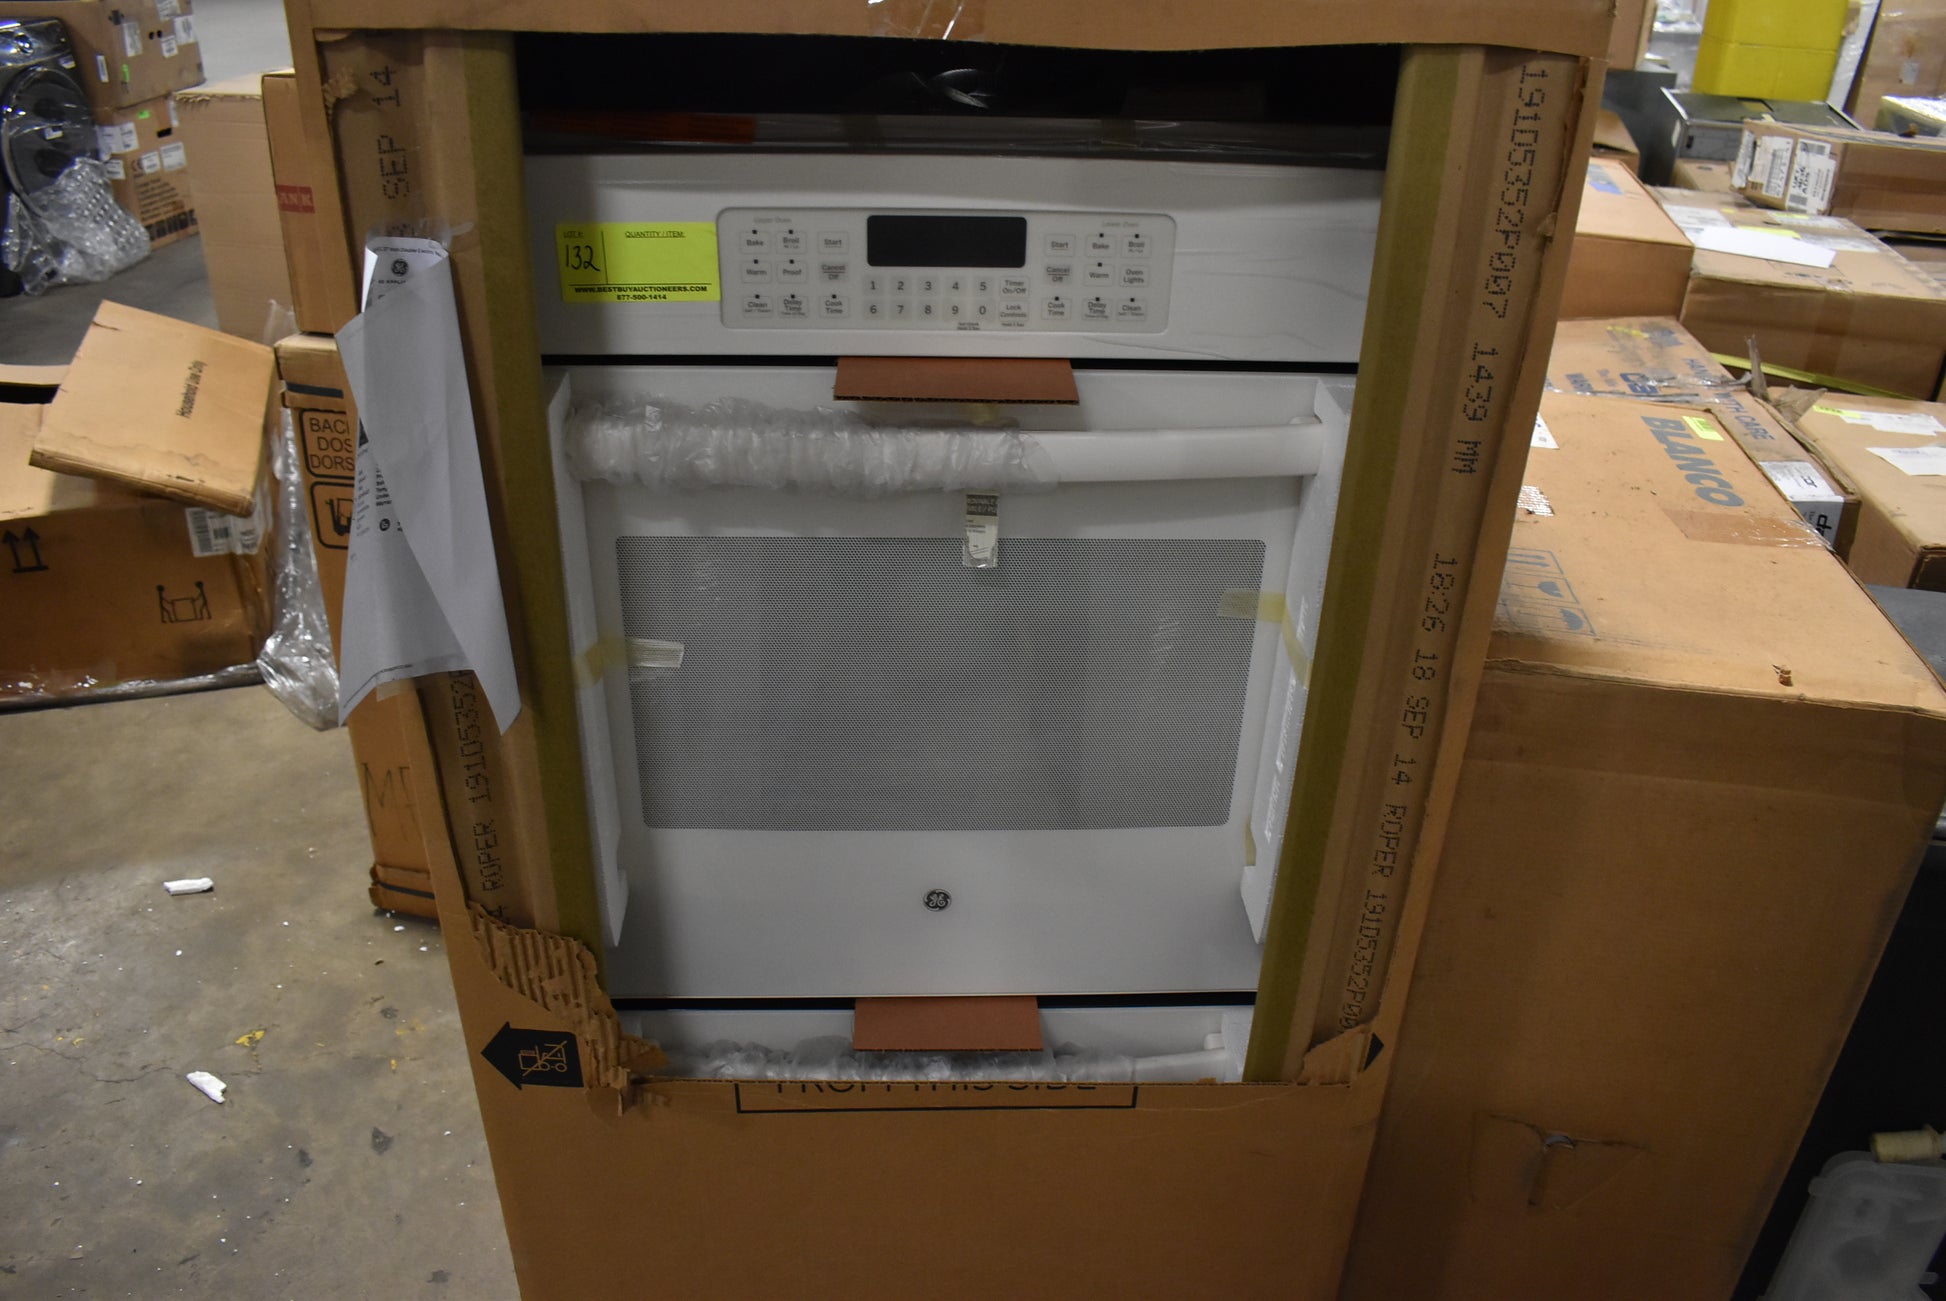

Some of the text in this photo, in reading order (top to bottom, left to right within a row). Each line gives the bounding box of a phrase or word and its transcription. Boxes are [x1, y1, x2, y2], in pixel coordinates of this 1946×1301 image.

[370, 65, 400, 107] 14
[378, 134, 410, 199] SEP
[746, 239, 764, 247] Bake
[565, 244, 600, 272] 132
[870, 281, 876, 290] 1
[897, 281, 904, 291] 2
[925, 281, 932, 291] 3
[952, 281, 960, 291] 4
[980, 282, 987, 291] 5
[870, 305, 877, 314] 6
[897, 305, 904, 314] 7
[925, 305, 932, 315] 8
[952, 306, 959, 315] 9
[979, 306, 987, 315] 0
[1462, 342, 1498, 422] 1439
[310, 417, 350, 434] BAC
[1735, 414, 1775, 441] CARE
[310, 454, 355, 471] DORS
[1452, 440, 1482, 475] MM
[1641, 416, 1744, 507] BLANCO
[1339, 553, 1458, 1034] 18:26 18 SEP 14 ROPER 191D5352P00
[473, 819, 504, 892] ROPER
